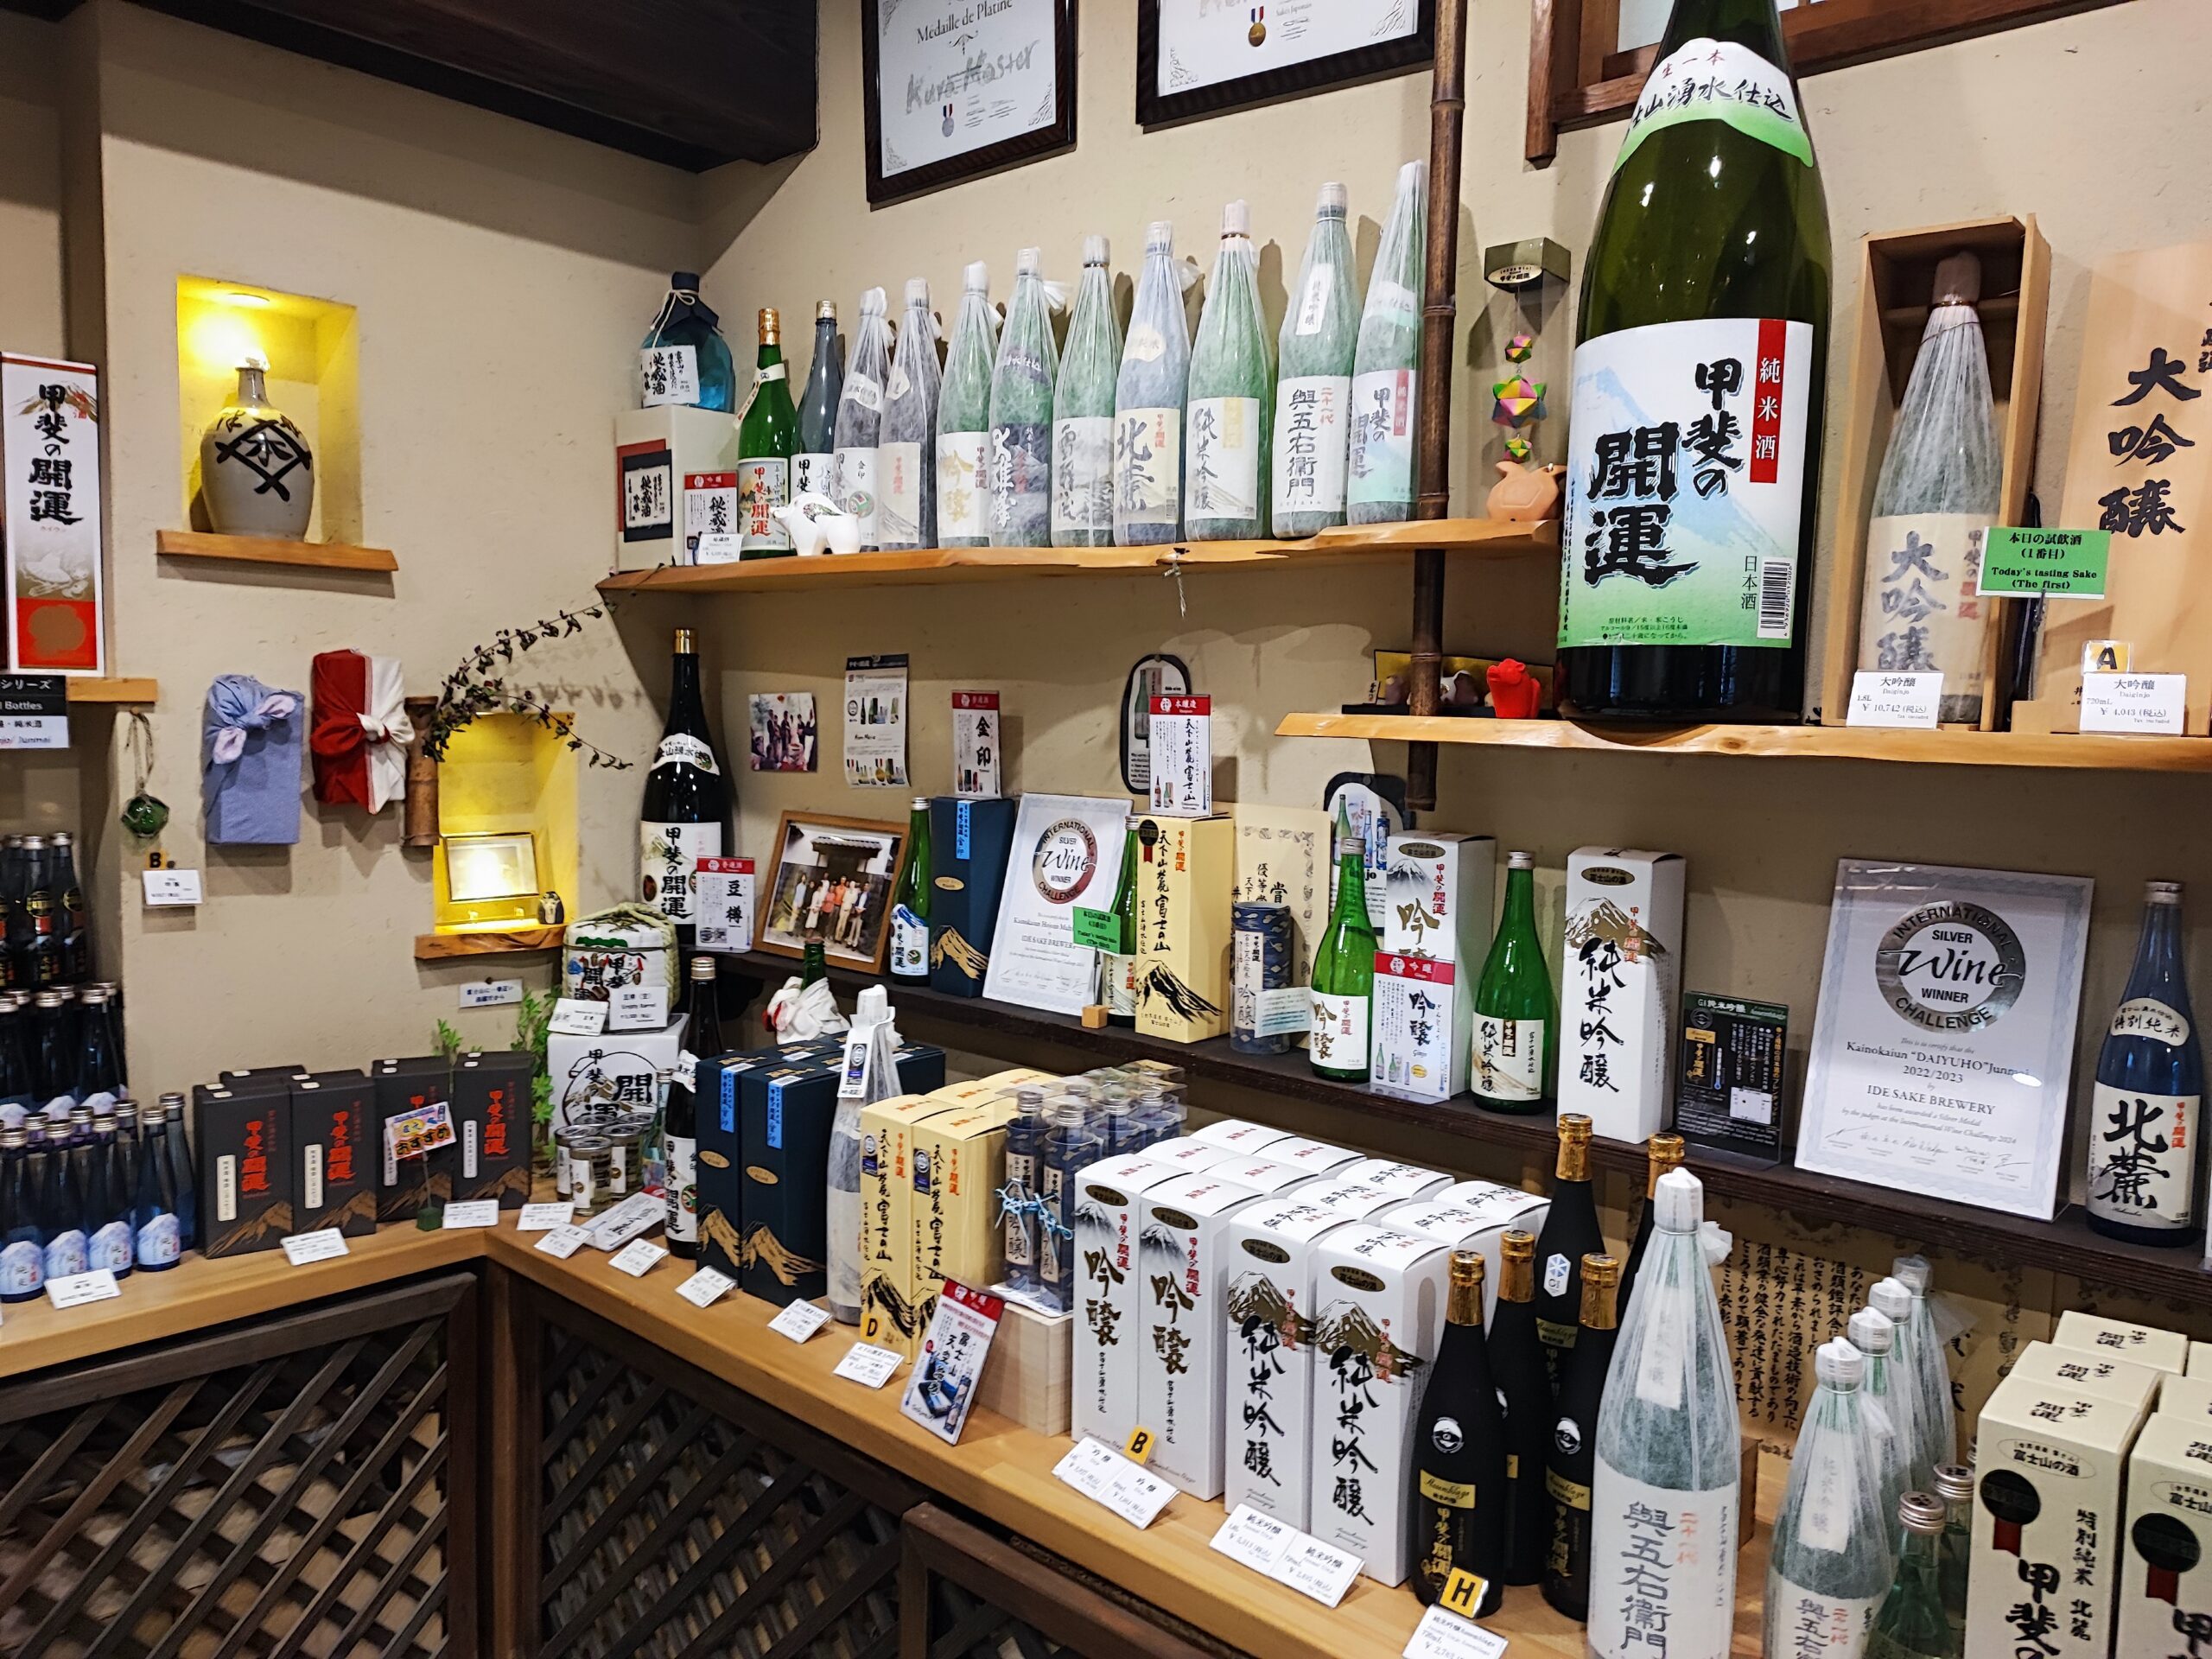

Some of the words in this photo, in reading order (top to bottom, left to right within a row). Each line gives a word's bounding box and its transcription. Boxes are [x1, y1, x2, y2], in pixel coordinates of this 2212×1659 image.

[963, 8, 974, 26] de
[1755, 357, 1782, 462] 純米酒
[1681, 357, 1745, 499] 甲斐の
[2099, 347, 2202, 538] 大吟醸
[2009, 532, 2082, 545] 本日の試飲酒
[1741, 556, 1758, 610] 日本酒
[1992, 567, 2031, 577] Today's
[2035, 568, 2069, 578] tasting
[2072, 569, 2097, 579] Sake
[2012, 580, 2038, 588] (The
[2042, 580, 2070, 589] first)
[2096, 647, 2118, 670] A
[1879, 677, 1917, 687] 大吟醸
[2113, 679, 2156, 690] 大吟醸
[4, 701, 44, 710] Bottles
[976, 715, 992, 767] 金印
[1042, 821, 1094, 850] INTERNATIONAL
[1058, 836, 1077, 845] SILVER
[149, 852, 162, 868] B
[1037, 848, 1094, 873] Wine
[660, 826, 695, 920] 甲斐の開運
[725, 879, 743, 925] 豆樽
[1039, 880, 1081, 901] CHALLENGE
[1892, 905, 2012, 950] INTERNATIONAL
[1931, 930, 1974, 944] SILVER
[1880, 948, 2020, 988] Wine
[1921, 988, 1969, 1003] WINNER
[1579, 937, 1628, 1092] 純米吟醸
[1895, 996, 1993, 1030] CHALLENGE
[1846, 1040, 1909, 1060] Kainokaiun
[1903, 1065, 1964, 1084] 2022/2023
[1866, 1084, 1890, 1097] IDE
[1892, 1088, 1926, 1103] SAKE
[1929, 1095, 1996, 1116] BREWERY
[867, 1317, 879, 1338] D
[1240, 1314, 1287, 1488] 純米吟醸
[1131, 1431, 1148, 1453] B
[1328, 1344, 1381, 1527] 純米吟醸
[1451, 1577, 1476, 1607] H
